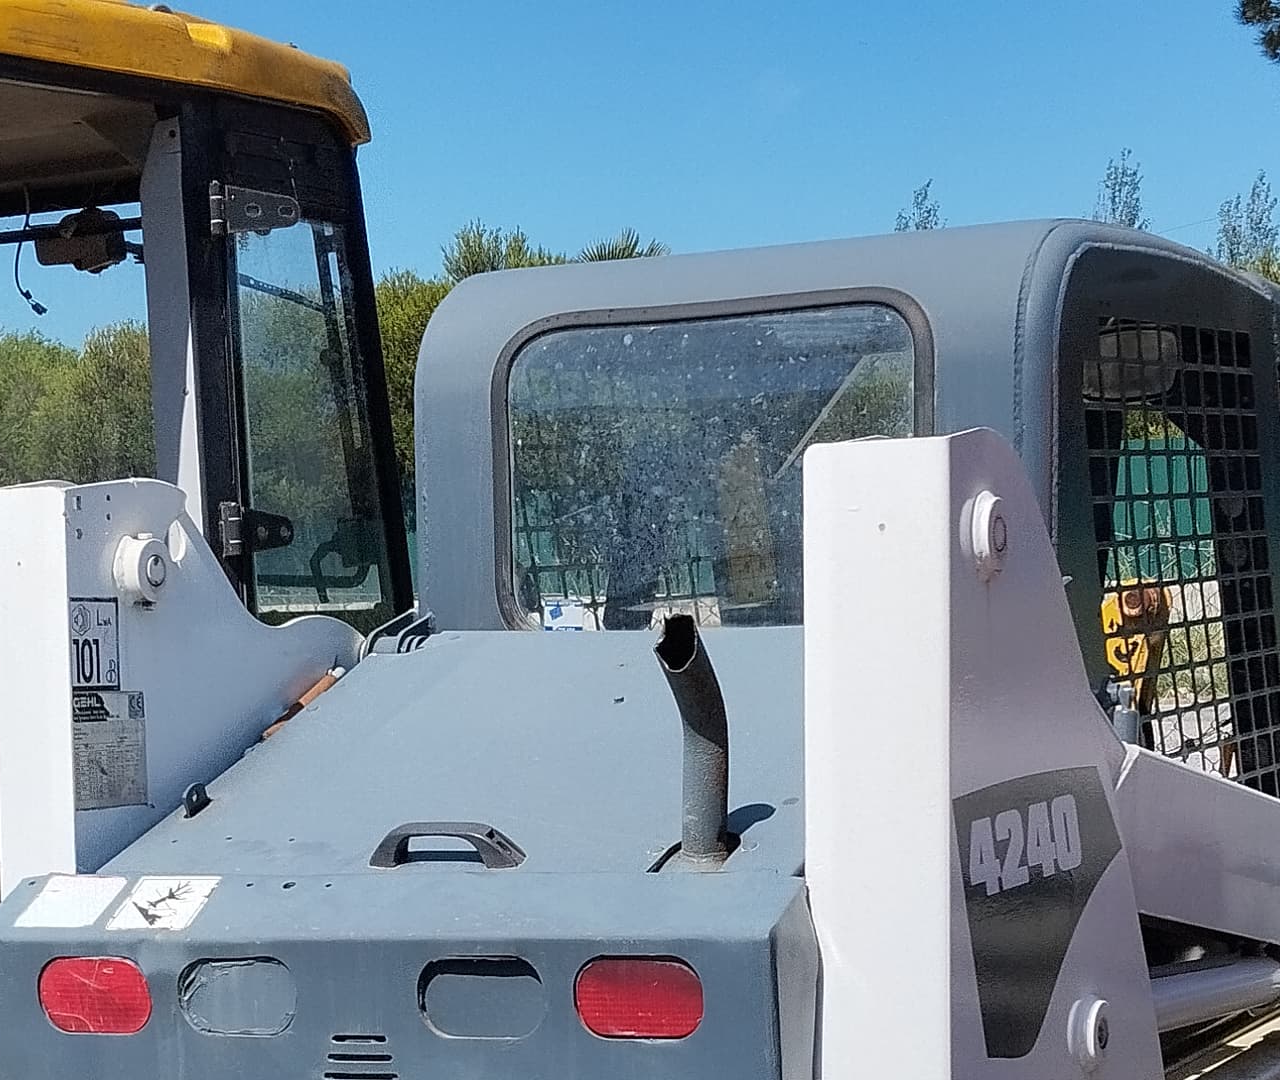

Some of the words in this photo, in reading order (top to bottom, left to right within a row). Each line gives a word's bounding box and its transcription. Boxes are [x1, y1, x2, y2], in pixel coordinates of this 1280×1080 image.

[72, 638, 101, 684] 101
[73, 696, 102, 708] GEHL
[970, 794, 1082, 896] 4240
